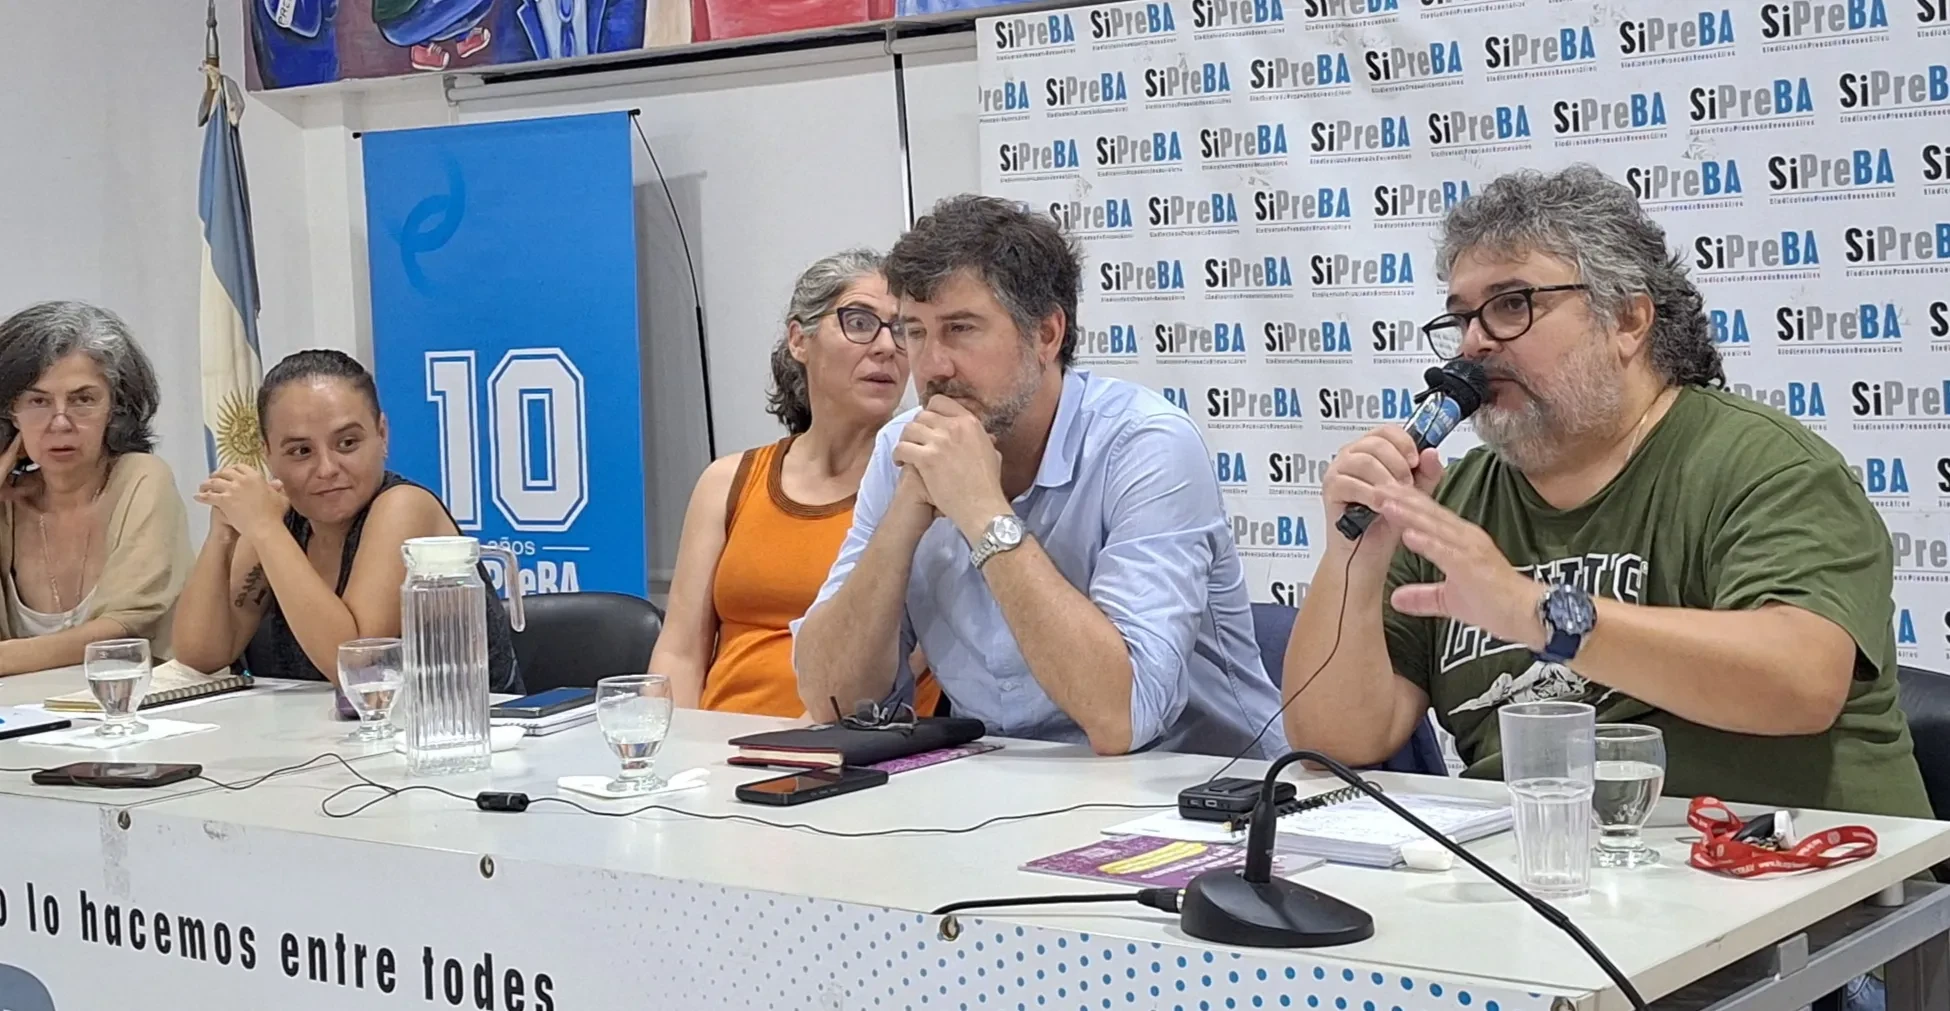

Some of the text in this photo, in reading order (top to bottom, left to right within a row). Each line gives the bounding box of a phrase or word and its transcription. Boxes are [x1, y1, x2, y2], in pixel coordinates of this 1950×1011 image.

[995, 14, 1075, 49] SiPreBA
[1091, 2, 1175, 39] SiPreBA
[1620, 9, 1734, 55] SiPreBA
[1761, 0, 1888, 40] SiPreBA
[1365, 41, 1463, 81] SiPreBA
[1485, 26, 1595, 68] SiPreBA
[1046, 71, 1127, 106] SiPreBA
[1145, 61, 1230, 97] SiPreBA
[1250, 53, 1351, 89] SiPreBA
[1839, 65, 1950, 109] SiPreB
[1554, 92, 1666, 135] SiPreBA
[1690, 77, 1814, 122] SiPreBA
[1200, 124, 1287, 158] SiPreBA
[1311, 115, 1410, 152] SiPreBA
[1429, 105, 1531, 144] SiPreBA
[1000, 139, 1079, 171] SiPreBA
[1096, 131, 1182, 165] SiPreBA
[1627, 159, 1742, 200] SiPreBA
[1768, 148, 1895, 190] SiPreBA
[1050, 199, 1132, 231] SiPreBA
[1149, 193, 1238, 225] SiPreBA
[1254, 187, 1351, 221] SiPreBA
[1695, 230, 1820, 269] SiPreBA
[1101, 260, 1184, 290] SiPreBA
[1205, 256, 1292, 288] SiPreBA
[1311, 252, 1414, 285] SiPreBA
[1077, 325, 1138, 354] PreBA
[1155, 323, 1245, 353] SiPreBA
[1264, 322, 1352, 352] SiPreBA
[1777, 303, 1902, 341] SiPreBA
[1207, 387, 1302, 418] SiPreBA
[1319, 388, 1413, 420] SiPreBA
[424, 347, 588, 532] 10
[1234, 516, 1309, 548] PreBA
[27, 882, 59, 936] lo
[80, 890, 256, 970] hacemos
[281, 932, 396, 994] entre
[423, 946, 554, 1011] todes
